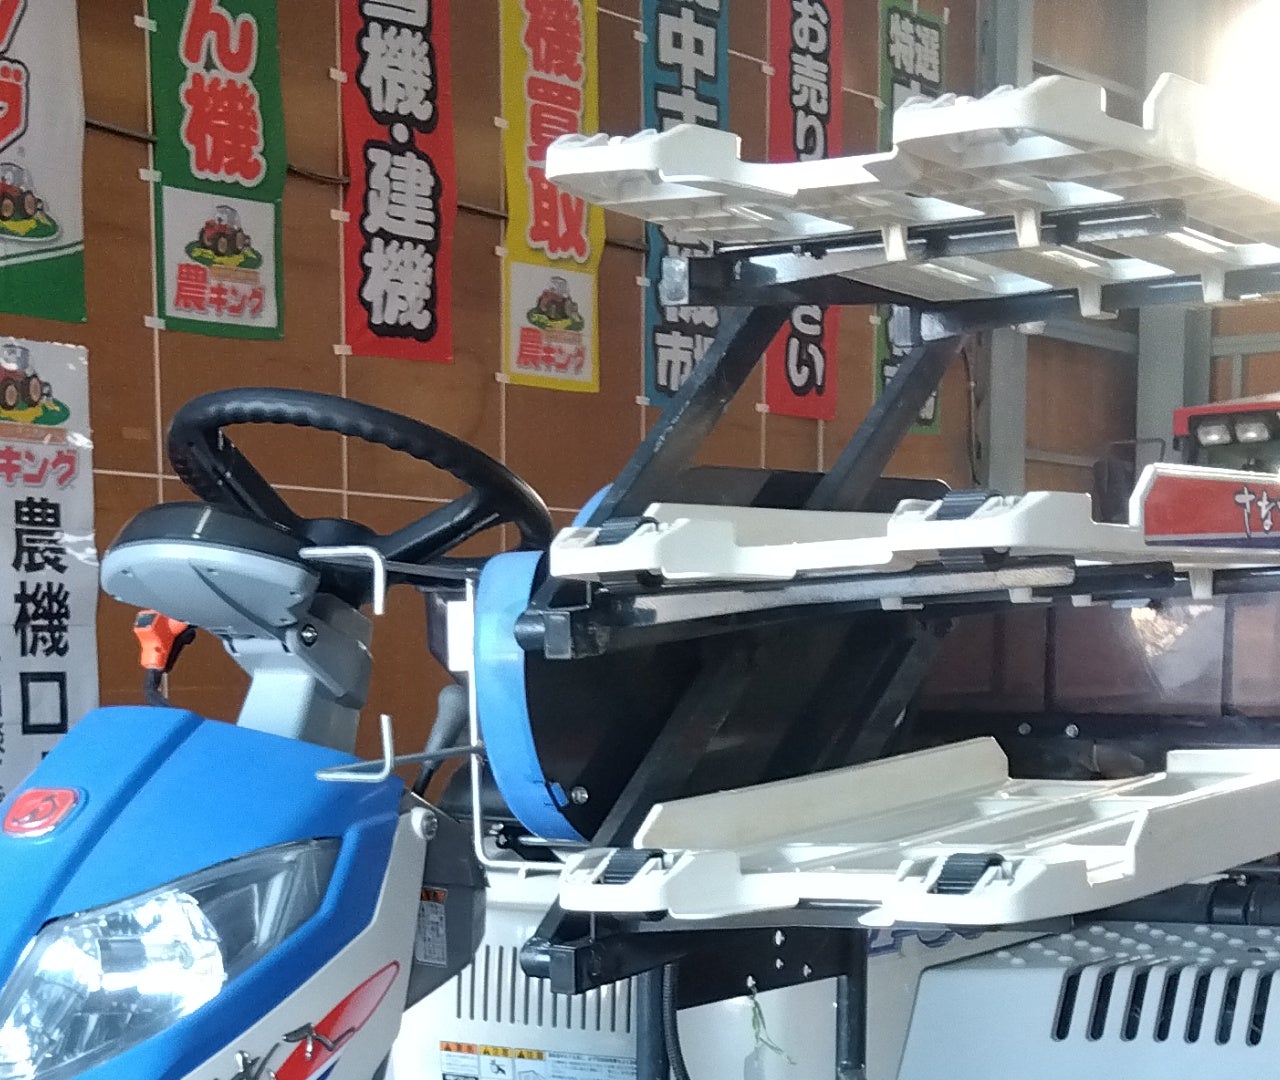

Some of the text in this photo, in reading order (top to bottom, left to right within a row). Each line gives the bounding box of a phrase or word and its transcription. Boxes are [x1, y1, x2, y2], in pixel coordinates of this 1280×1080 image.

[174, 262, 265, 316] 農キング
[516, 325, 585, 375] 農キング
